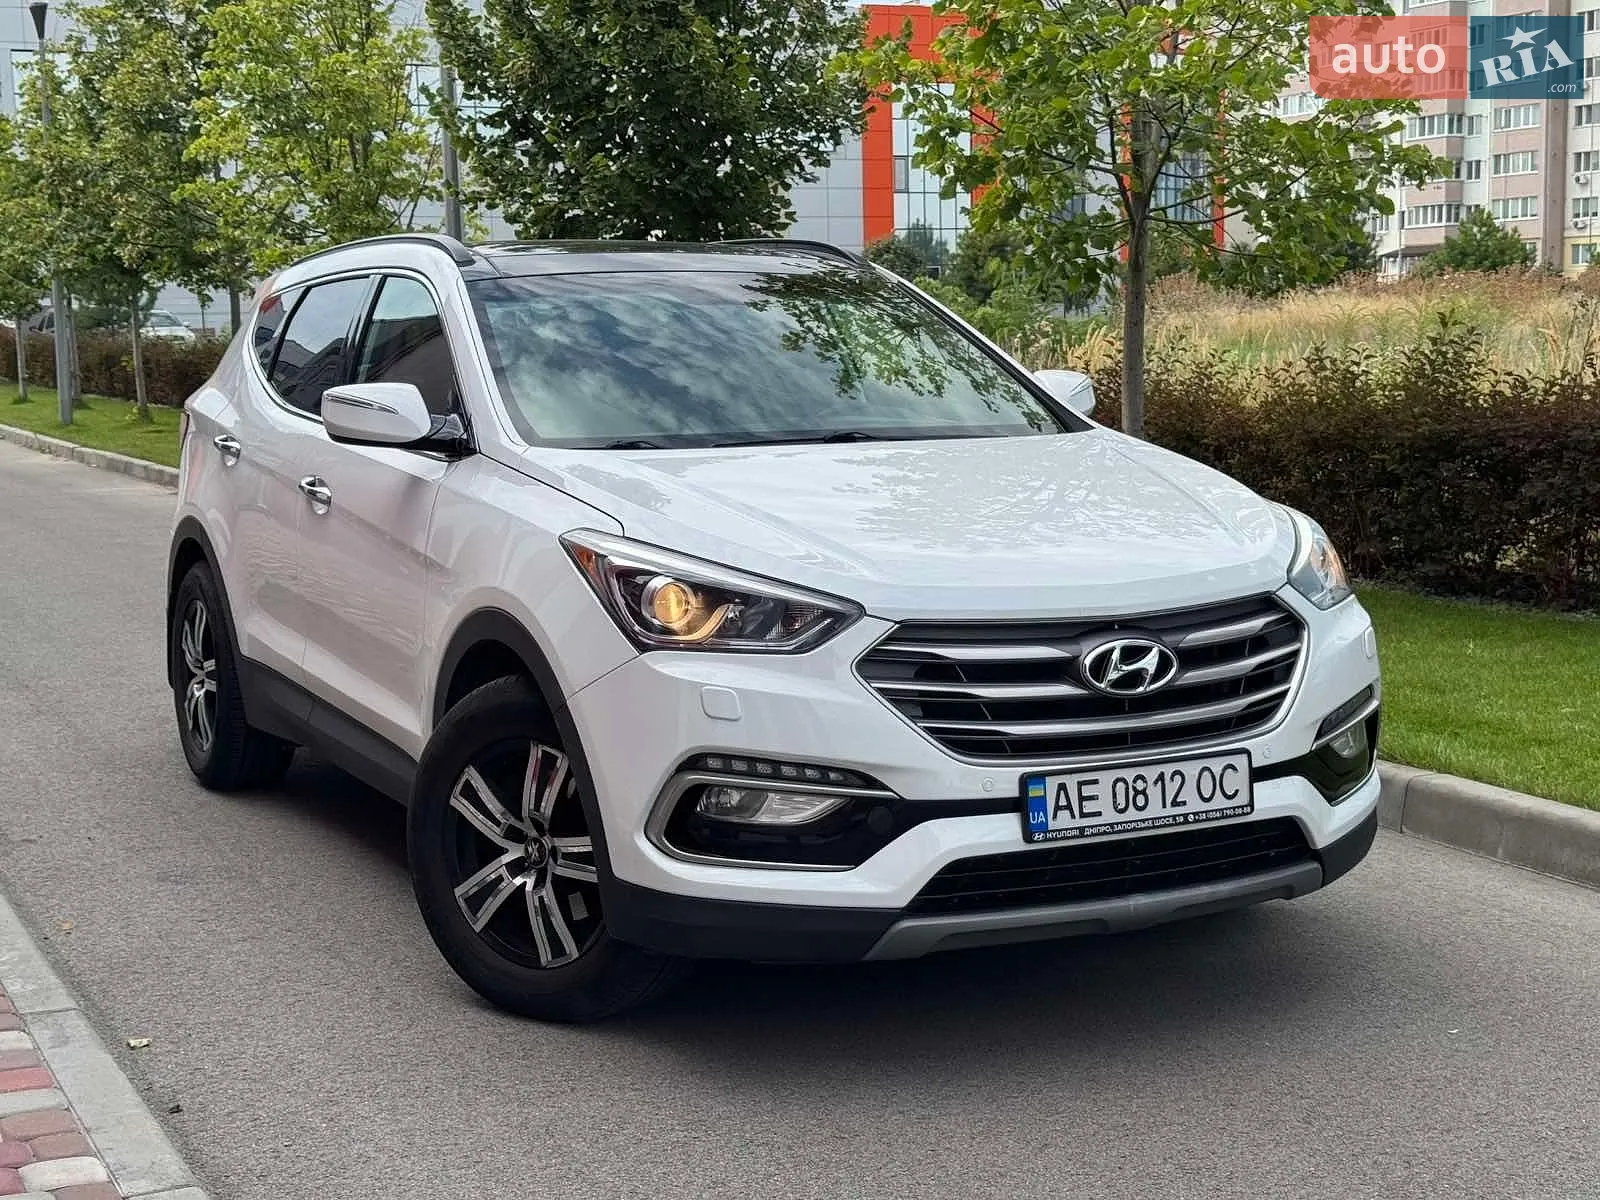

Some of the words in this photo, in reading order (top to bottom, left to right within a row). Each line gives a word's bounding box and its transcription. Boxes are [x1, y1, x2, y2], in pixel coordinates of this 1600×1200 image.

[1052, 778, 1103, 821] AE
[1112, 769, 1187, 814] 0812
[1196, 763, 1240, 802] OC
[1029, 811, 1046, 824] UA
[1046, 829, 1079, 839] HYUNDAI
